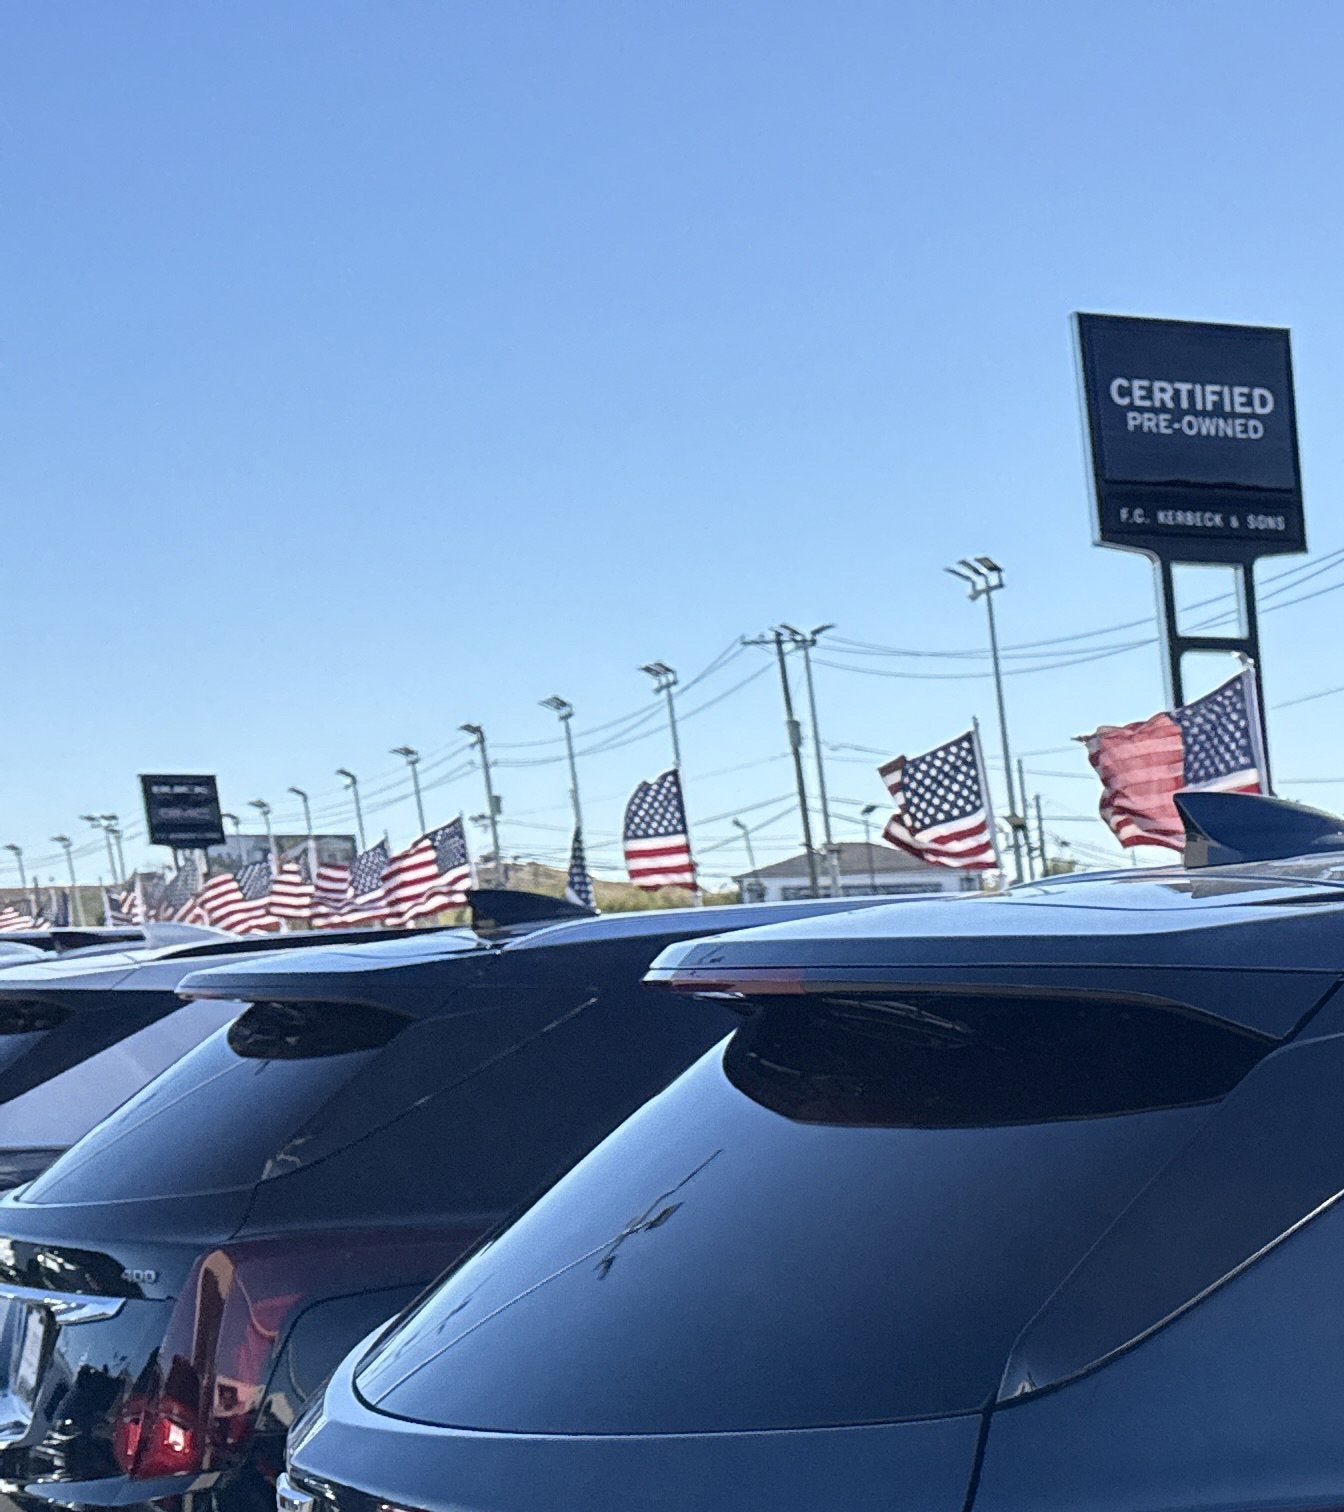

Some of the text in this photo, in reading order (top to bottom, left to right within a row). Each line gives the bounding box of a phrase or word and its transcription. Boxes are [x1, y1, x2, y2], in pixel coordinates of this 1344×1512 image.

[1109, 377, 1275, 415] CERTIFIED
[1126, 411, 1265, 440] PRE-OWNED
[1119, 507, 1150, 524] F.C.
[1157, 510, 1224, 528] KERBECK
[1246, 513, 1286, 530] SONS
[121, 1269, 156, 1283] 400
